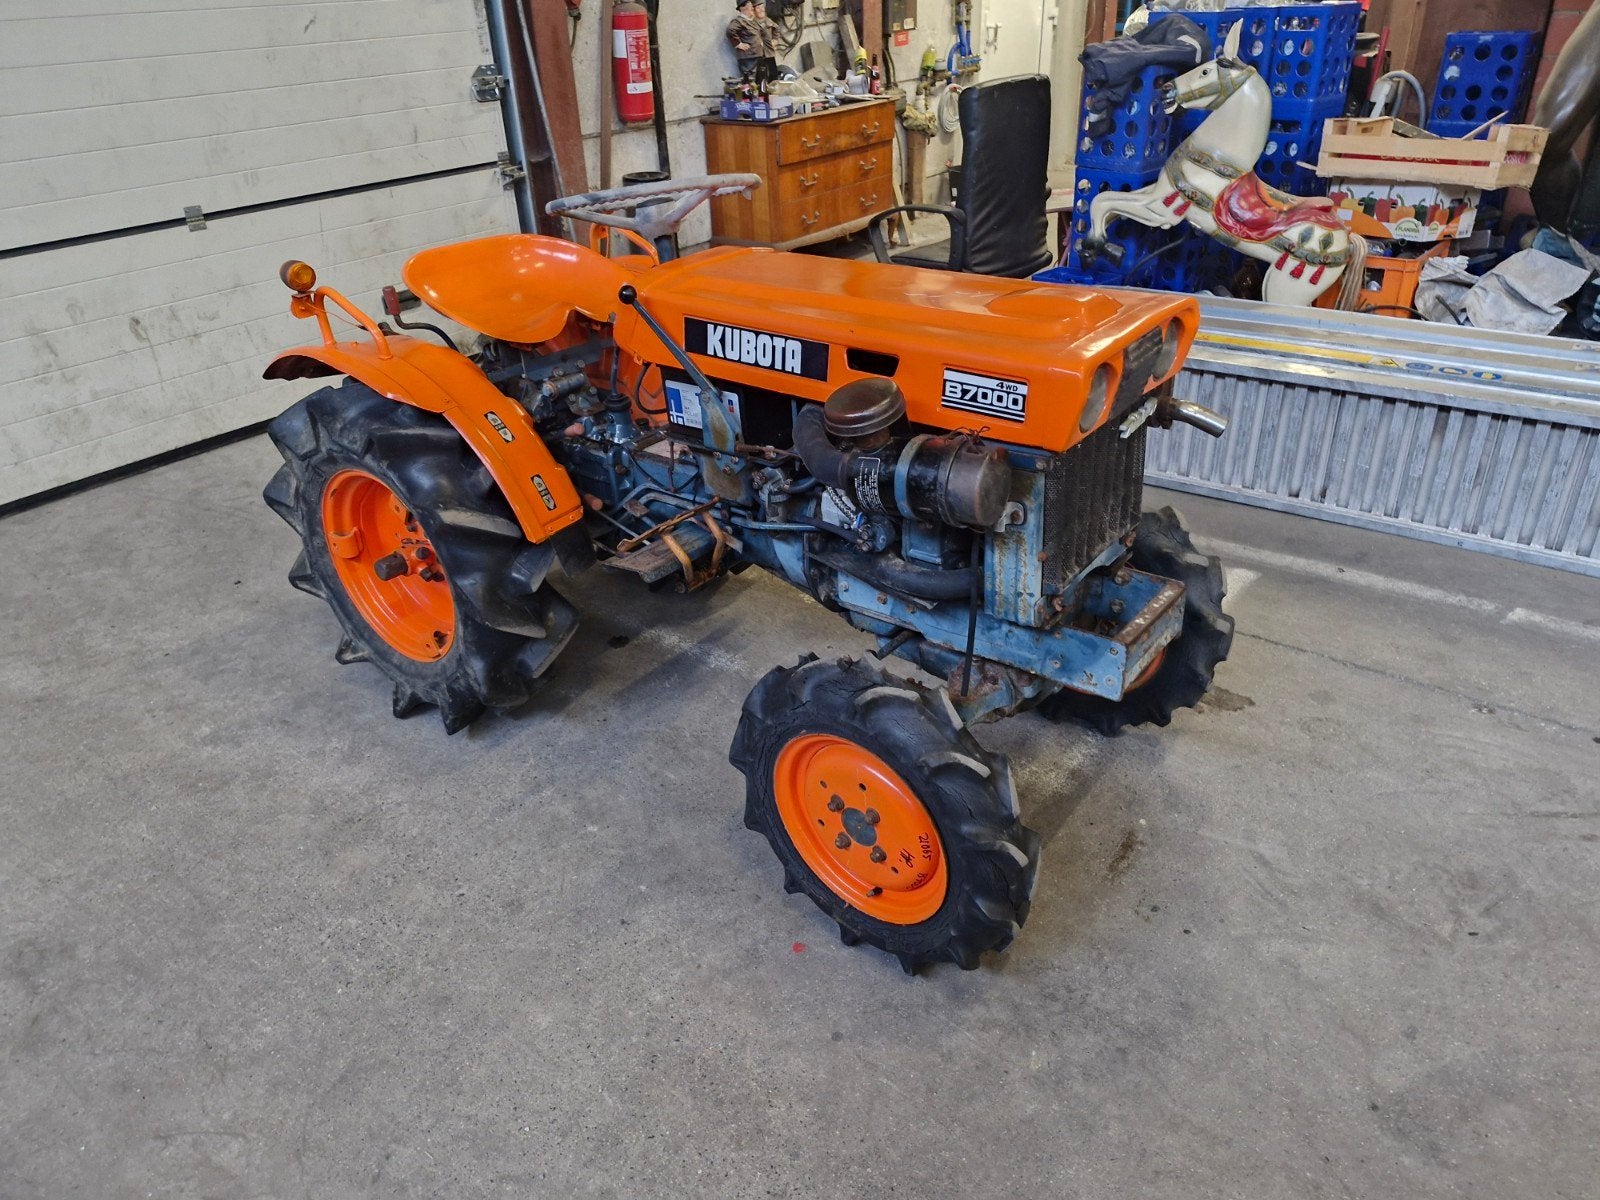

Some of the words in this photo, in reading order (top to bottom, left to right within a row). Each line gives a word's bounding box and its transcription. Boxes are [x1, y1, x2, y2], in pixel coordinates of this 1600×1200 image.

[707, 323, 802, 374] KUBOTA
[944, 381, 1024, 411] B7000
[995, 381, 1019, 392] 4WD
